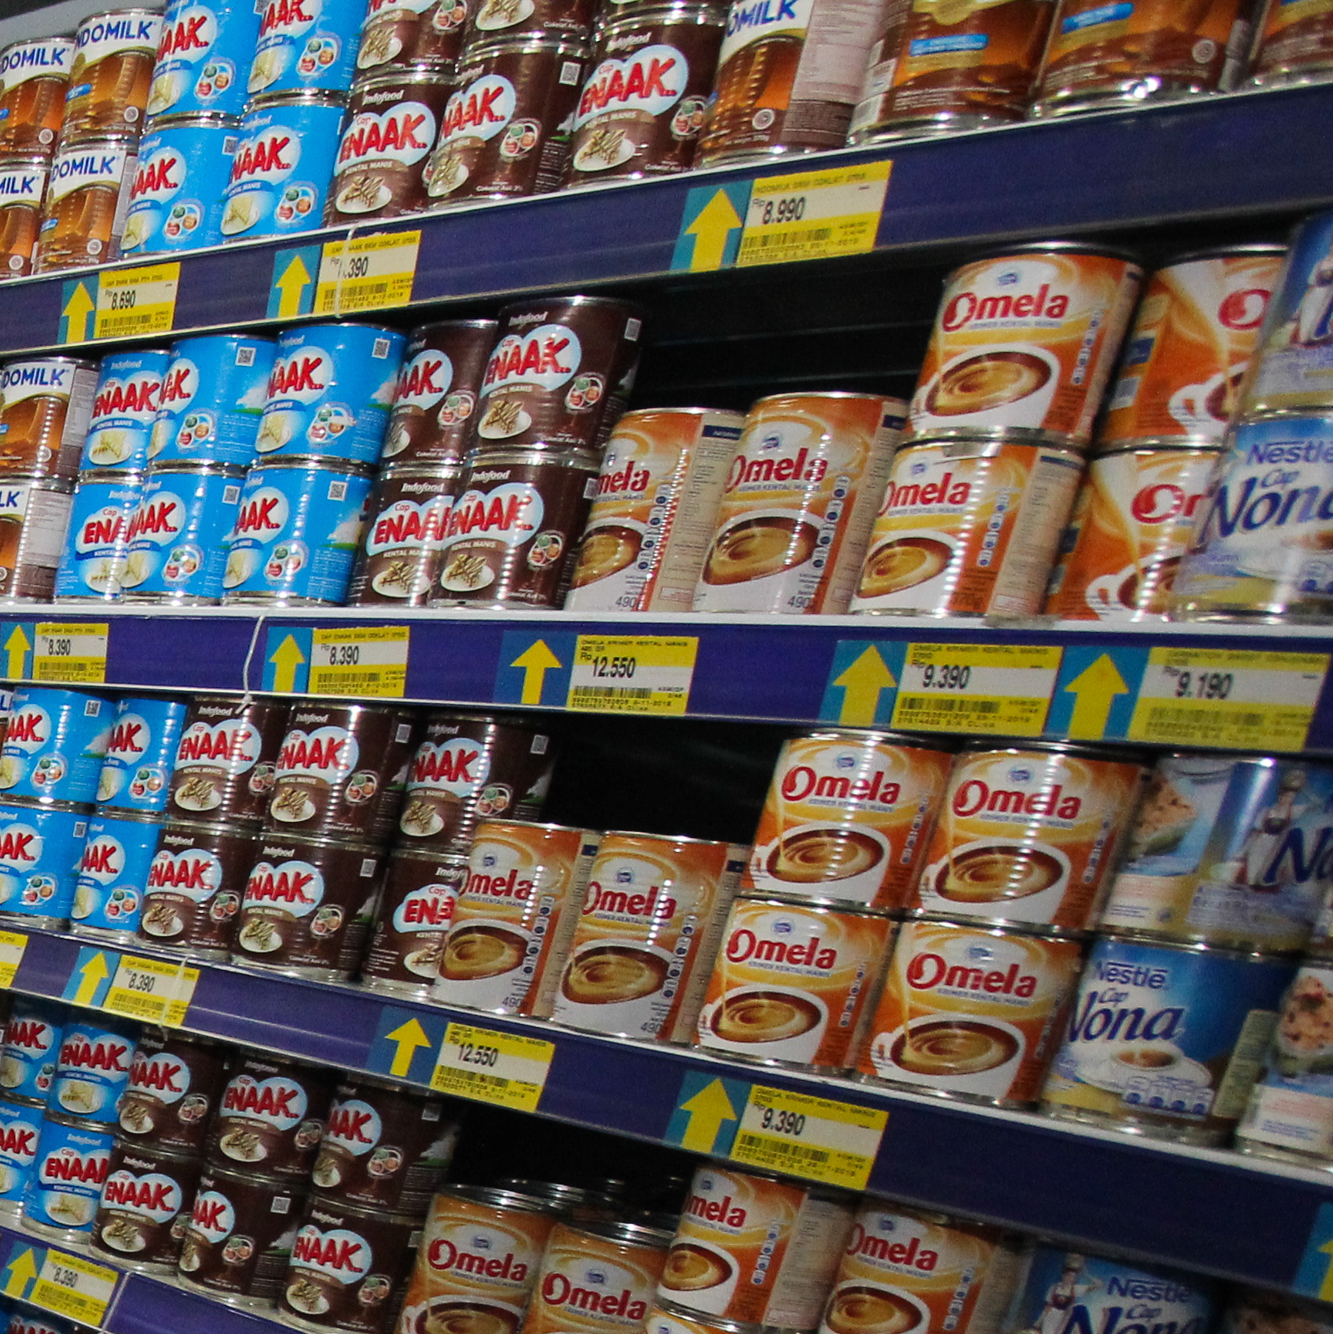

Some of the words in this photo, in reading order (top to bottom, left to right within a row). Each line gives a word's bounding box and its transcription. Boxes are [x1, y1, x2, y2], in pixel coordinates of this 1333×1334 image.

[763, 197, 806, 225] 8.990
[110, 290, 137, 311] 8.690
[942, 288, 1069, 334] Omela
[1260, 466, 1297, 490] Cap
[48, 637, 72, 657] 8.390
[329, 644, 360, 665] 8.390
[591, 655, 636, 679] 12.550
[922, 664, 971, 689] 9.390
[1173, 670, 1233, 700] 9.190
[177, 729, 254, 763] ENAAK
[781, 764, 901, 805] Omela
[952, 779, 1082, 821] Omela
[582, 880, 677, 924] Omela
[727, 927, 837, 971] Omela
[129, 975, 155, 993] 8.390
[905, 952, 1038, 999] Omela
[1098, 985, 1128, 1006] Cap
[456, 1043, 501, 1067] 12.550
[760, 1109, 806, 1137] 9.390
[104, 1179, 176, 1213] ENAAK
[427, 1237, 529, 1284] Omela
[52, 1264, 79, 1288] 8.390
[540, 1272, 648, 1321] Omela
[1124, 1302, 1161, 1322] Cap
